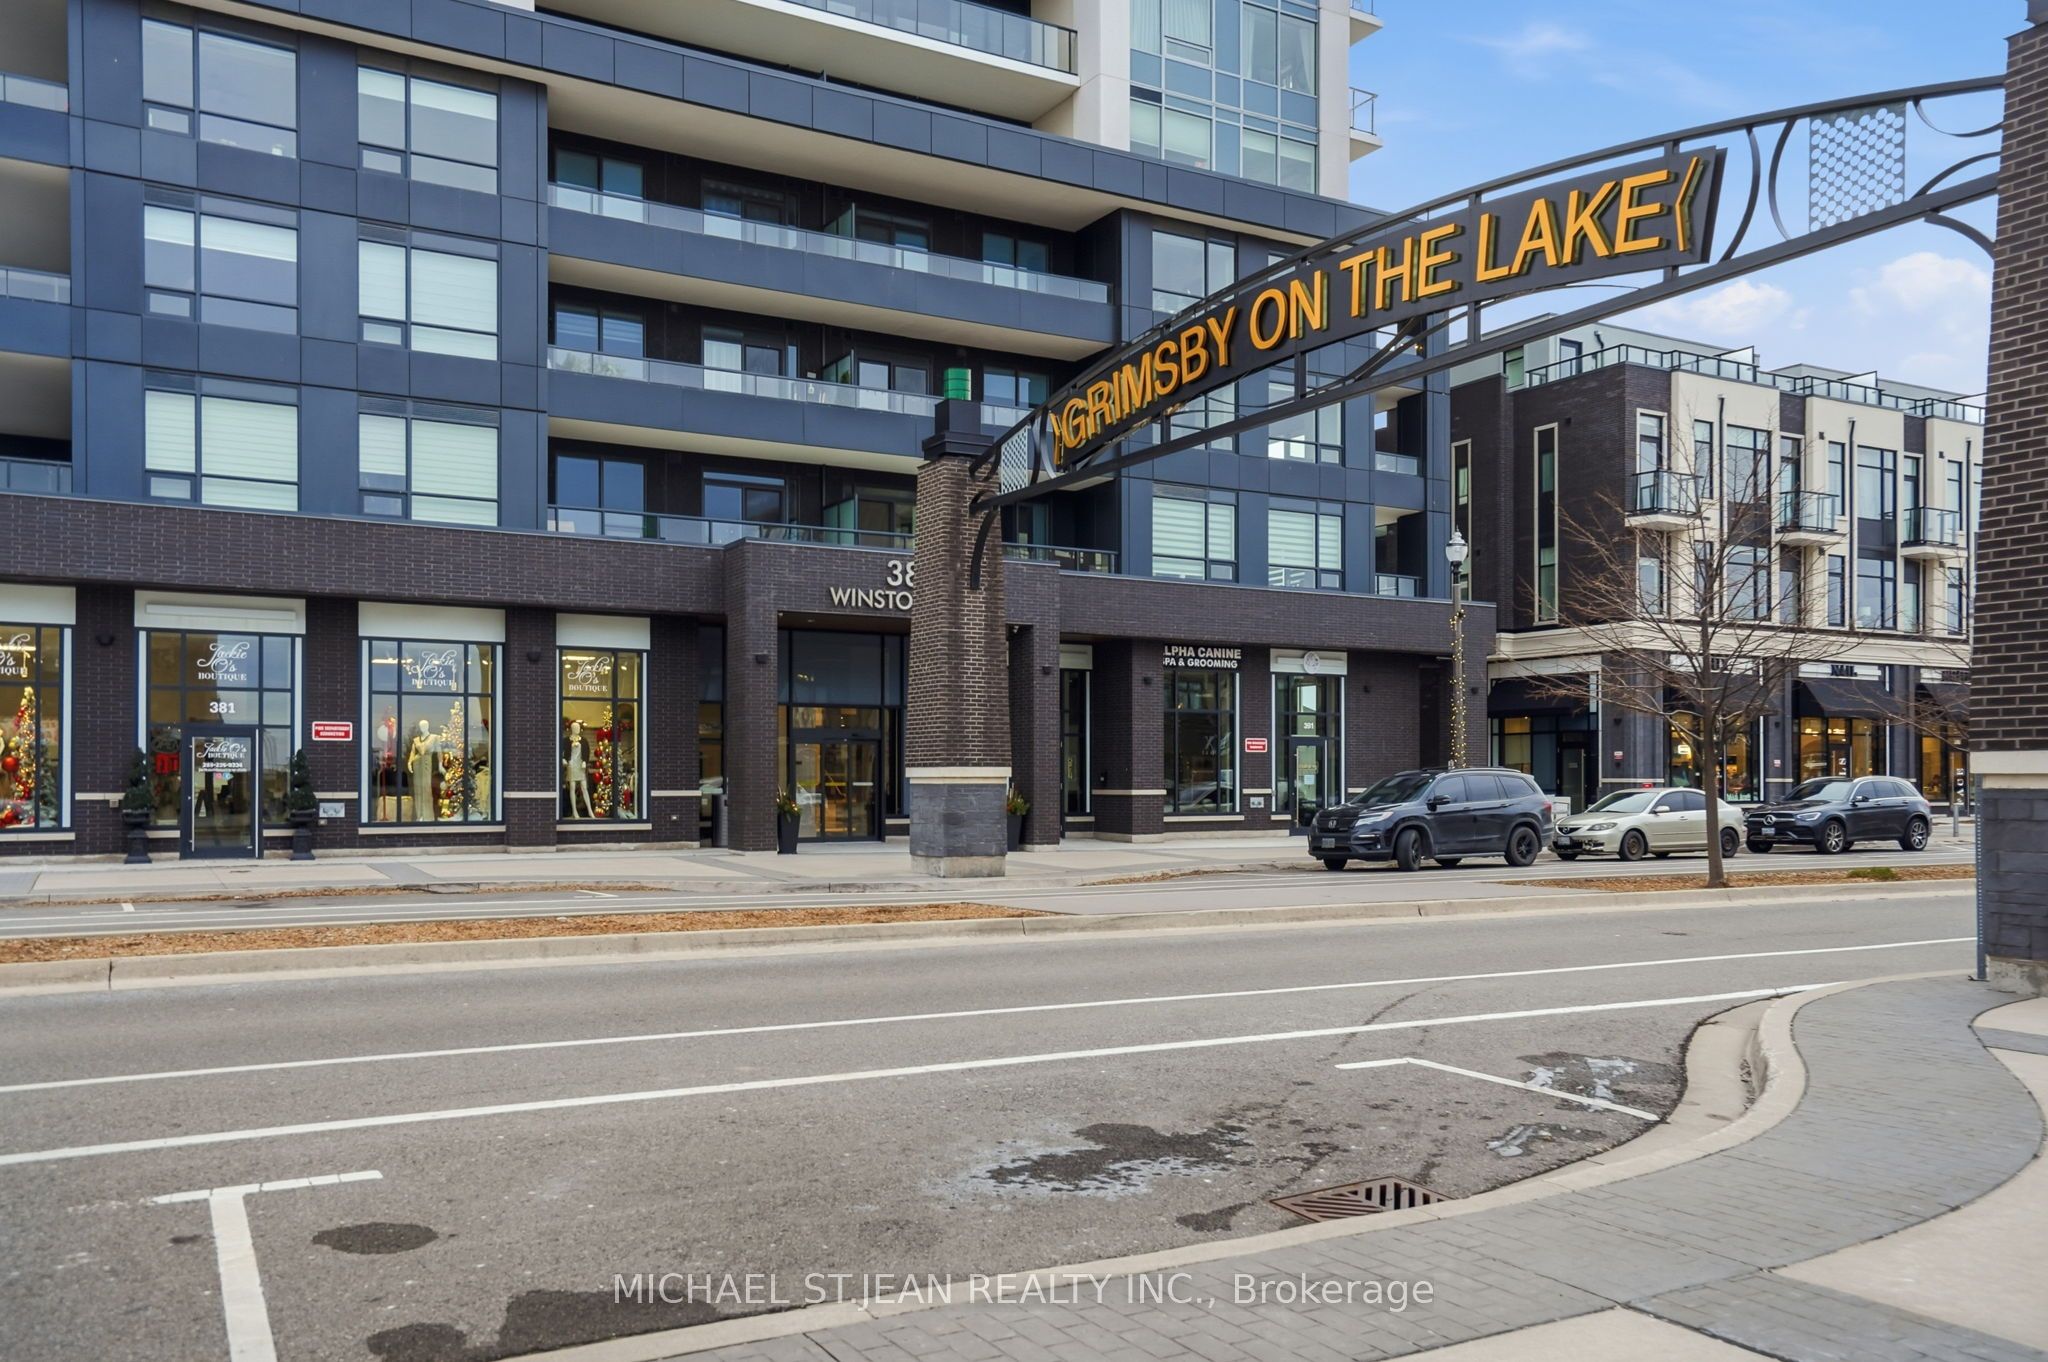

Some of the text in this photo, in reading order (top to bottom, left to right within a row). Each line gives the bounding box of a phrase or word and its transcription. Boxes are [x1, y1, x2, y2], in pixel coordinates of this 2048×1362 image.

[1061, 169, 1674, 449] GRIMSBY ON THE LAKE
[196, 641, 250, 667] Jackie
[1163, 645, 1242, 660] LPHA CANINE
[211, 658, 237, 673] O's
[1178, 658, 1186, 667] &
[1187, 658, 1239, 669] GROOMING
[197, 672, 248, 681] BOUTIQUE
[209, 701, 236, 713] 381
